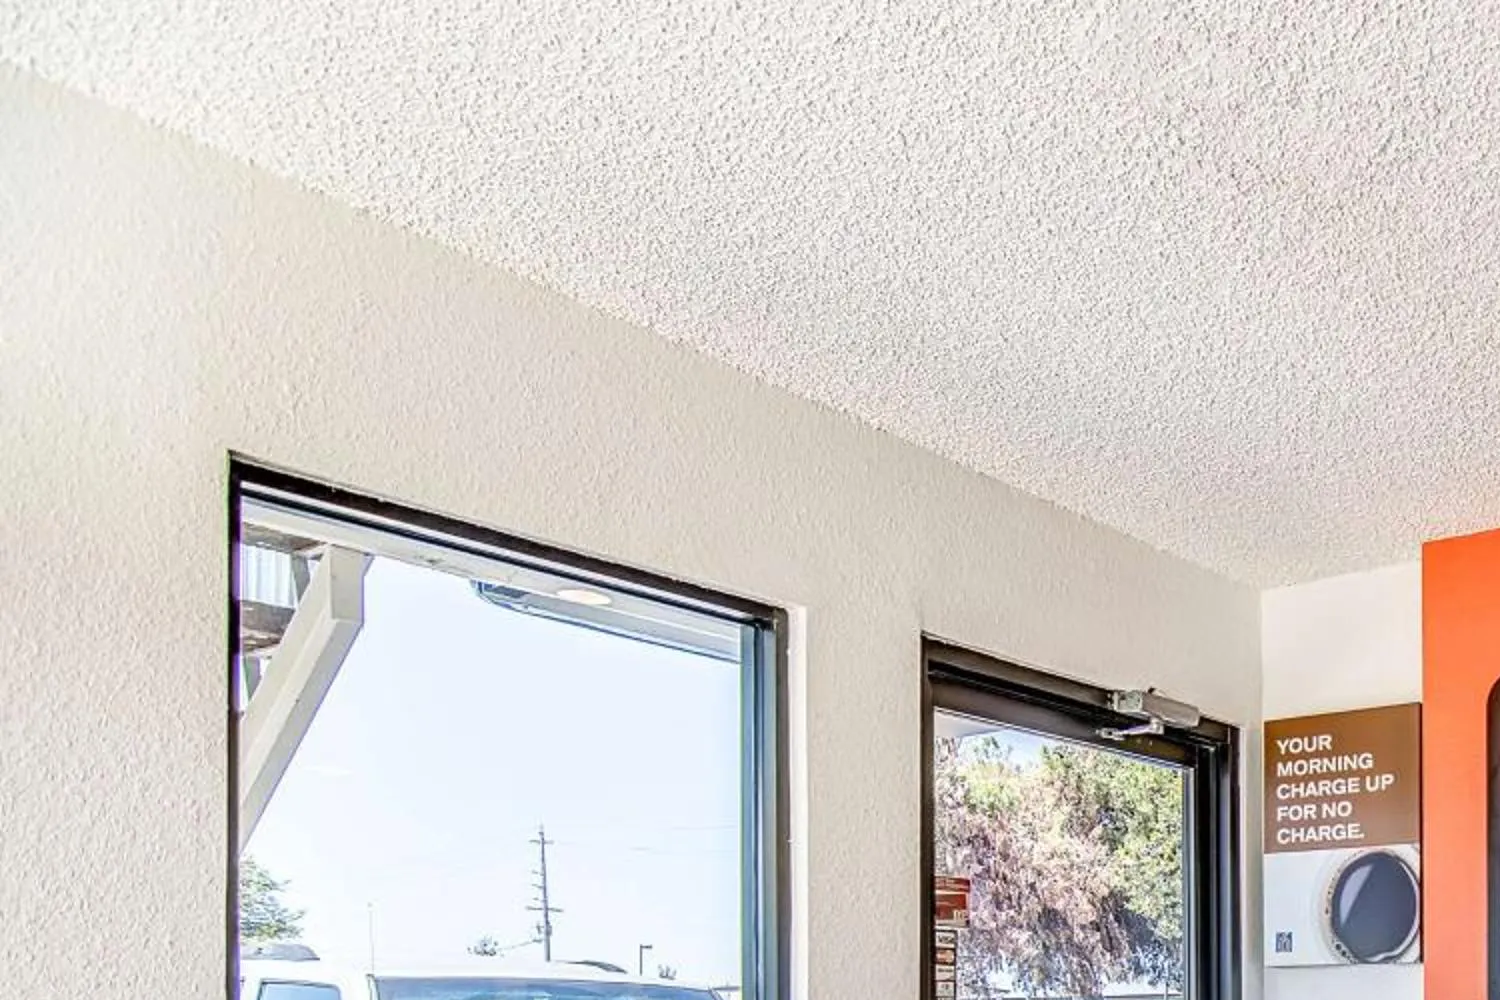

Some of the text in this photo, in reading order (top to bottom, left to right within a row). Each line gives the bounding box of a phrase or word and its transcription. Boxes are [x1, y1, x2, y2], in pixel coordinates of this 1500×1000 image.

[1276, 734, 1332, 755] YOUR
[1277, 753, 1373, 777] MORNING
[1277, 774, 1395, 800] CHARGE UP
[1277, 801, 1352, 822] FOR NO
[1277, 823, 1365, 844] CHARGE.
